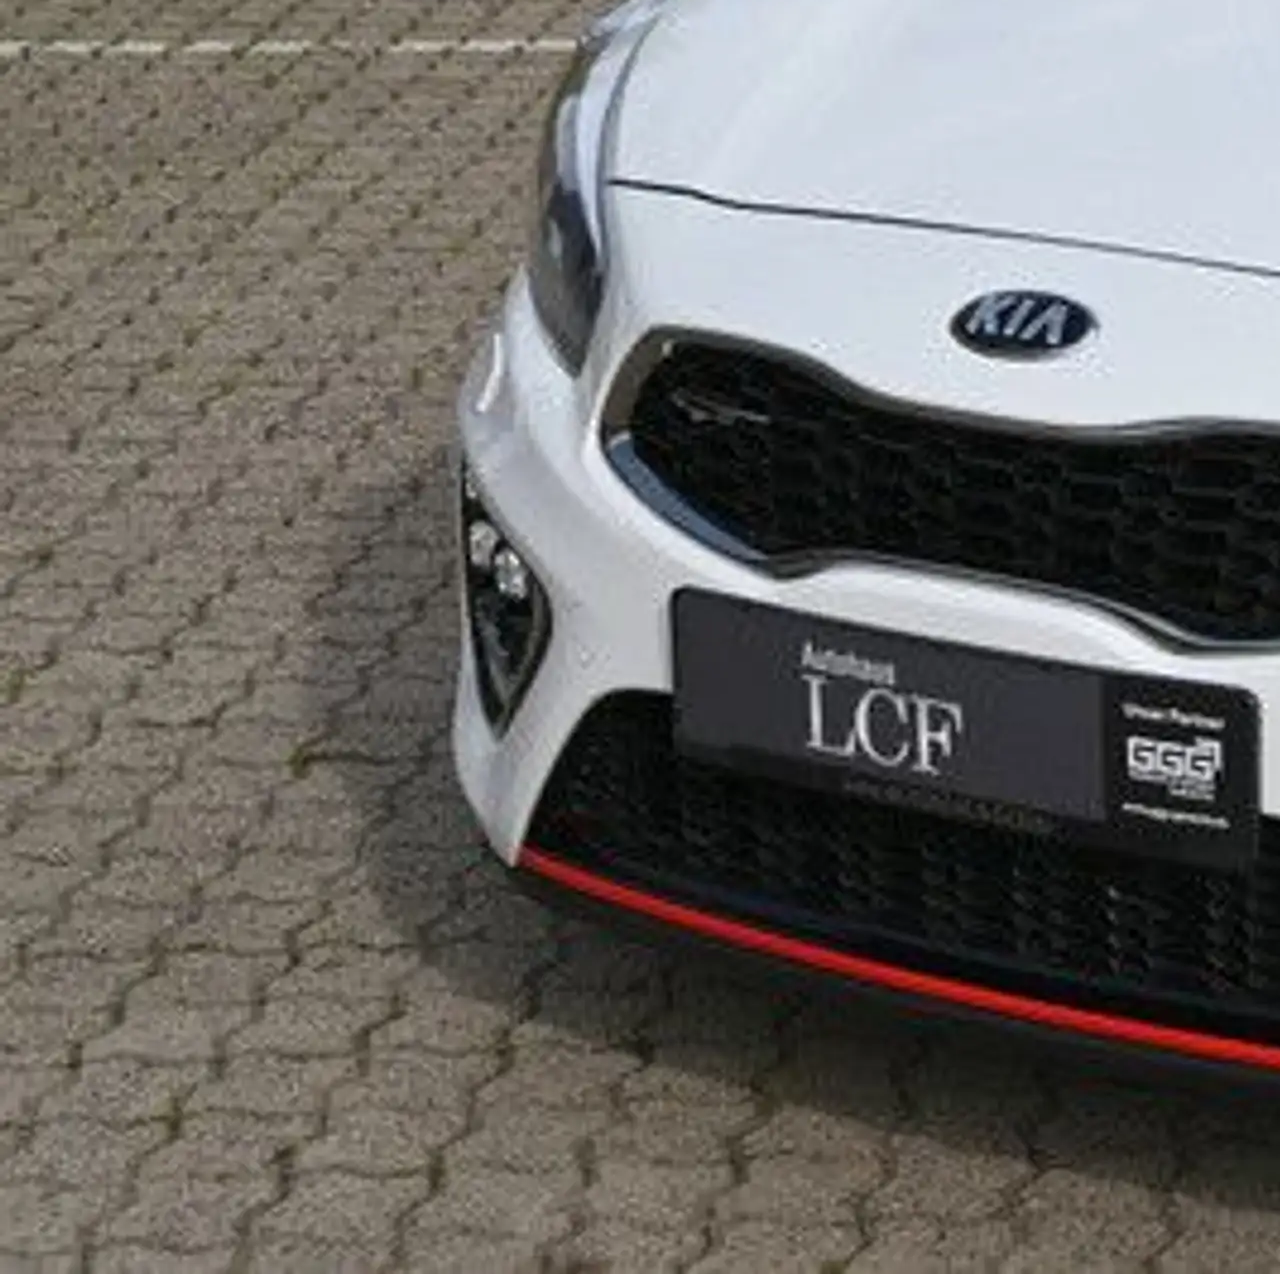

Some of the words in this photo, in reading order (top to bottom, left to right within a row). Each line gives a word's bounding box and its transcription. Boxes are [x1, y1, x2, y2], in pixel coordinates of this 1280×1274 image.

[964, 293, 1068, 345] KIA
[802, 642, 895, 685] Autohaus
[802, 674, 962, 776] LCF
